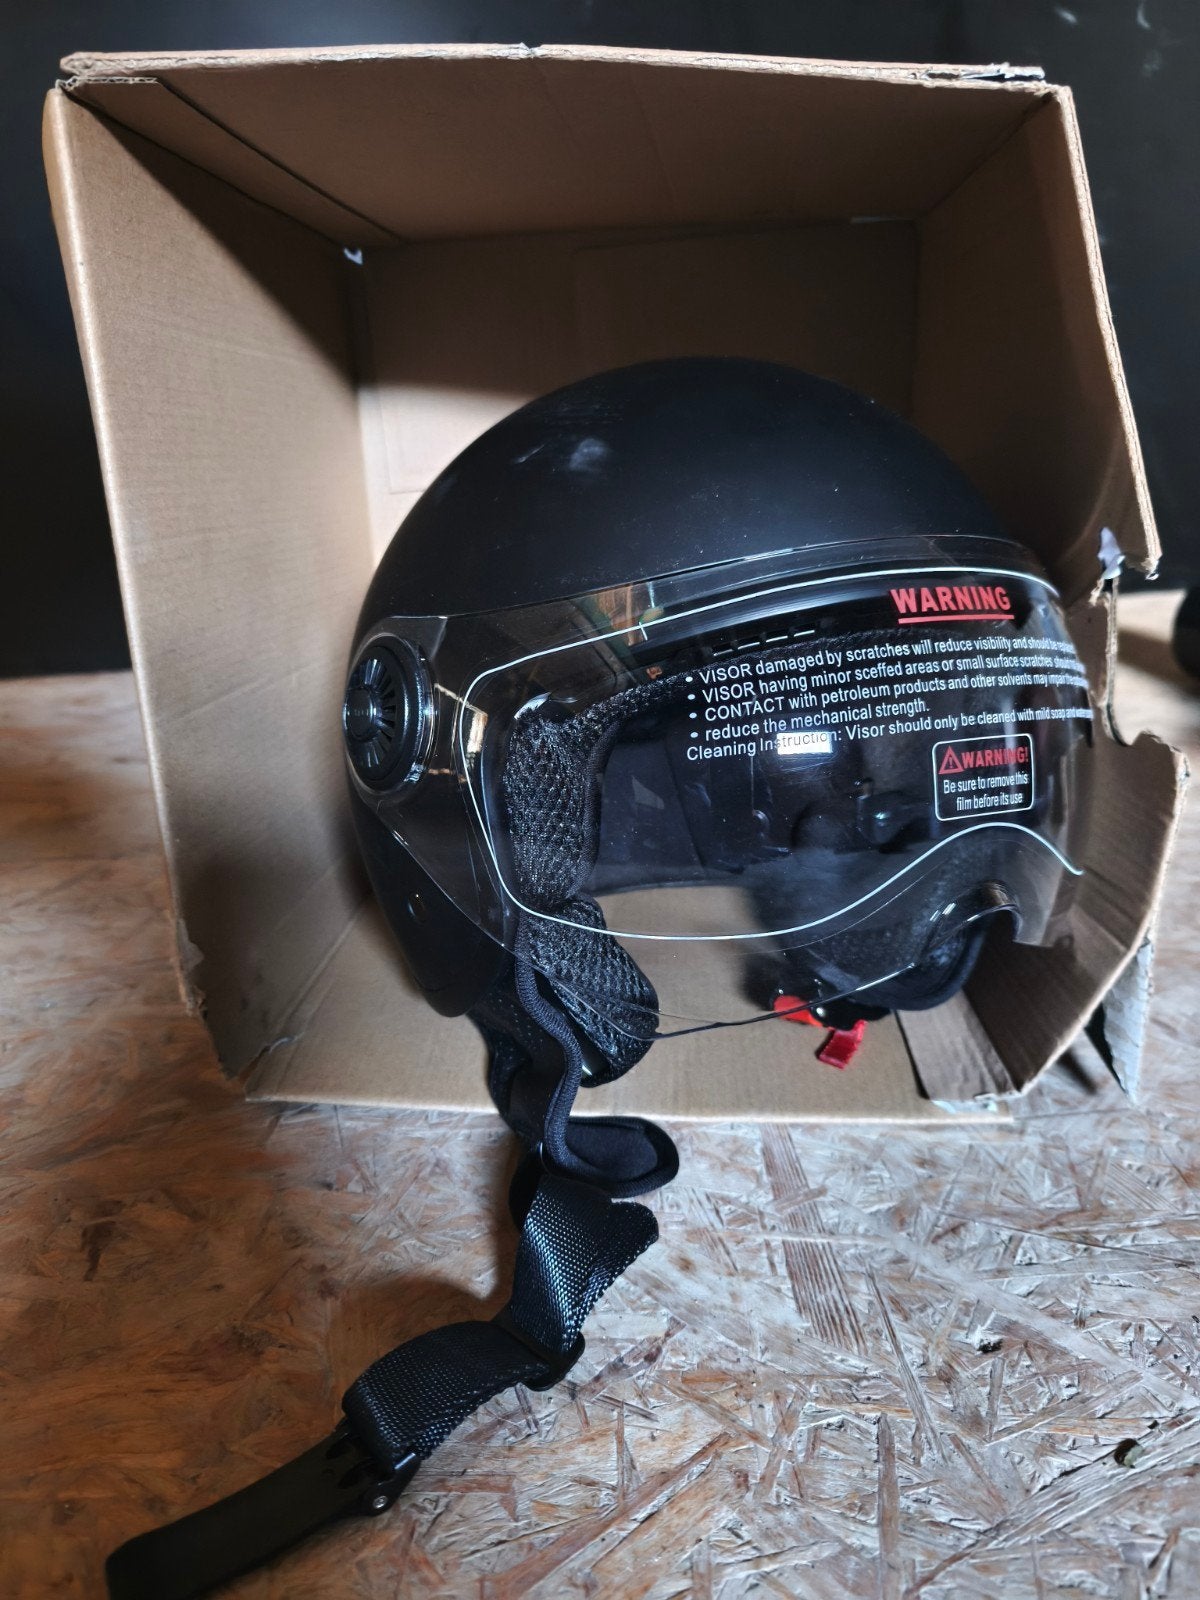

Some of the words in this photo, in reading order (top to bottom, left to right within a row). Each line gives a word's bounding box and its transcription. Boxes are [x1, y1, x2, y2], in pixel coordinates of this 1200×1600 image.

[890, 586, 1011, 614] WARNING
[699, 663, 753, 684] VISOR
[755, 650, 824, 675] damaged
[826, 650, 842, 668] by
[846, 643, 910, 661] scratches
[912, 639, 932, 655] will
[934, 638, 972, 653] reduce
[974, 636, 1011, 652] visibility
[1012, 637, 1027, 649] and
[702, 682, 757, 703] VISOR
[759, 675, 808, 694] having
[811, 670, 851, 688] minor
[855, 661, 903, 680] sceffed
[905, 661, 939, 675] areas
[941, 660, 953, 671] or
[956, 655, 984, 670] small
[986, 653, 1019, 668] surface
[1020, 655, 1053, 667] scratches
[705, 696, 784, 721] CONTACT
[789, 692, 817, 709] with
[821, 685, 890, 708] petroleum
[894, 678, 946, 698] products
[948, 675, 968, 689] and
[971, 674, 998, 688] other
[998, 673, 1032, 686] solvents
[1033, 674, 1048, 687] may
[687, 741, 756, 760] Cleaning
[760, 730, 842, 752] Instruction:
[845, 724, 885, 740] Visor
[888, 717, 931, 735] should
[934, 715, 958, 731] only
[961, 713, 975, 727] be
[977, 710, 1016, 725] cleaned
[1017, 708, 1034, 721] with
[1035, 707, 1050, 720] mild
[705, 723, 760, 741] reduce
[763, 718, 787, 733] the
[791, 704, 872, 729] mechanical
[875, 698, 930, 718] strength.
[962, 746, 1029, 769] WARNING!
[943, 779, 956, 794] Be
[957, 779, 977, 792] sure
[978, 776, 986, 789] to
[987, 775, 1015, 789] remove
[1015, 771, 1029, 785] this
[956, 796, 971, 811] film
[973, 794, 999, 809] before
[1000, 792, 1009, 805] its
[1010, 792, 1023, 804] use
